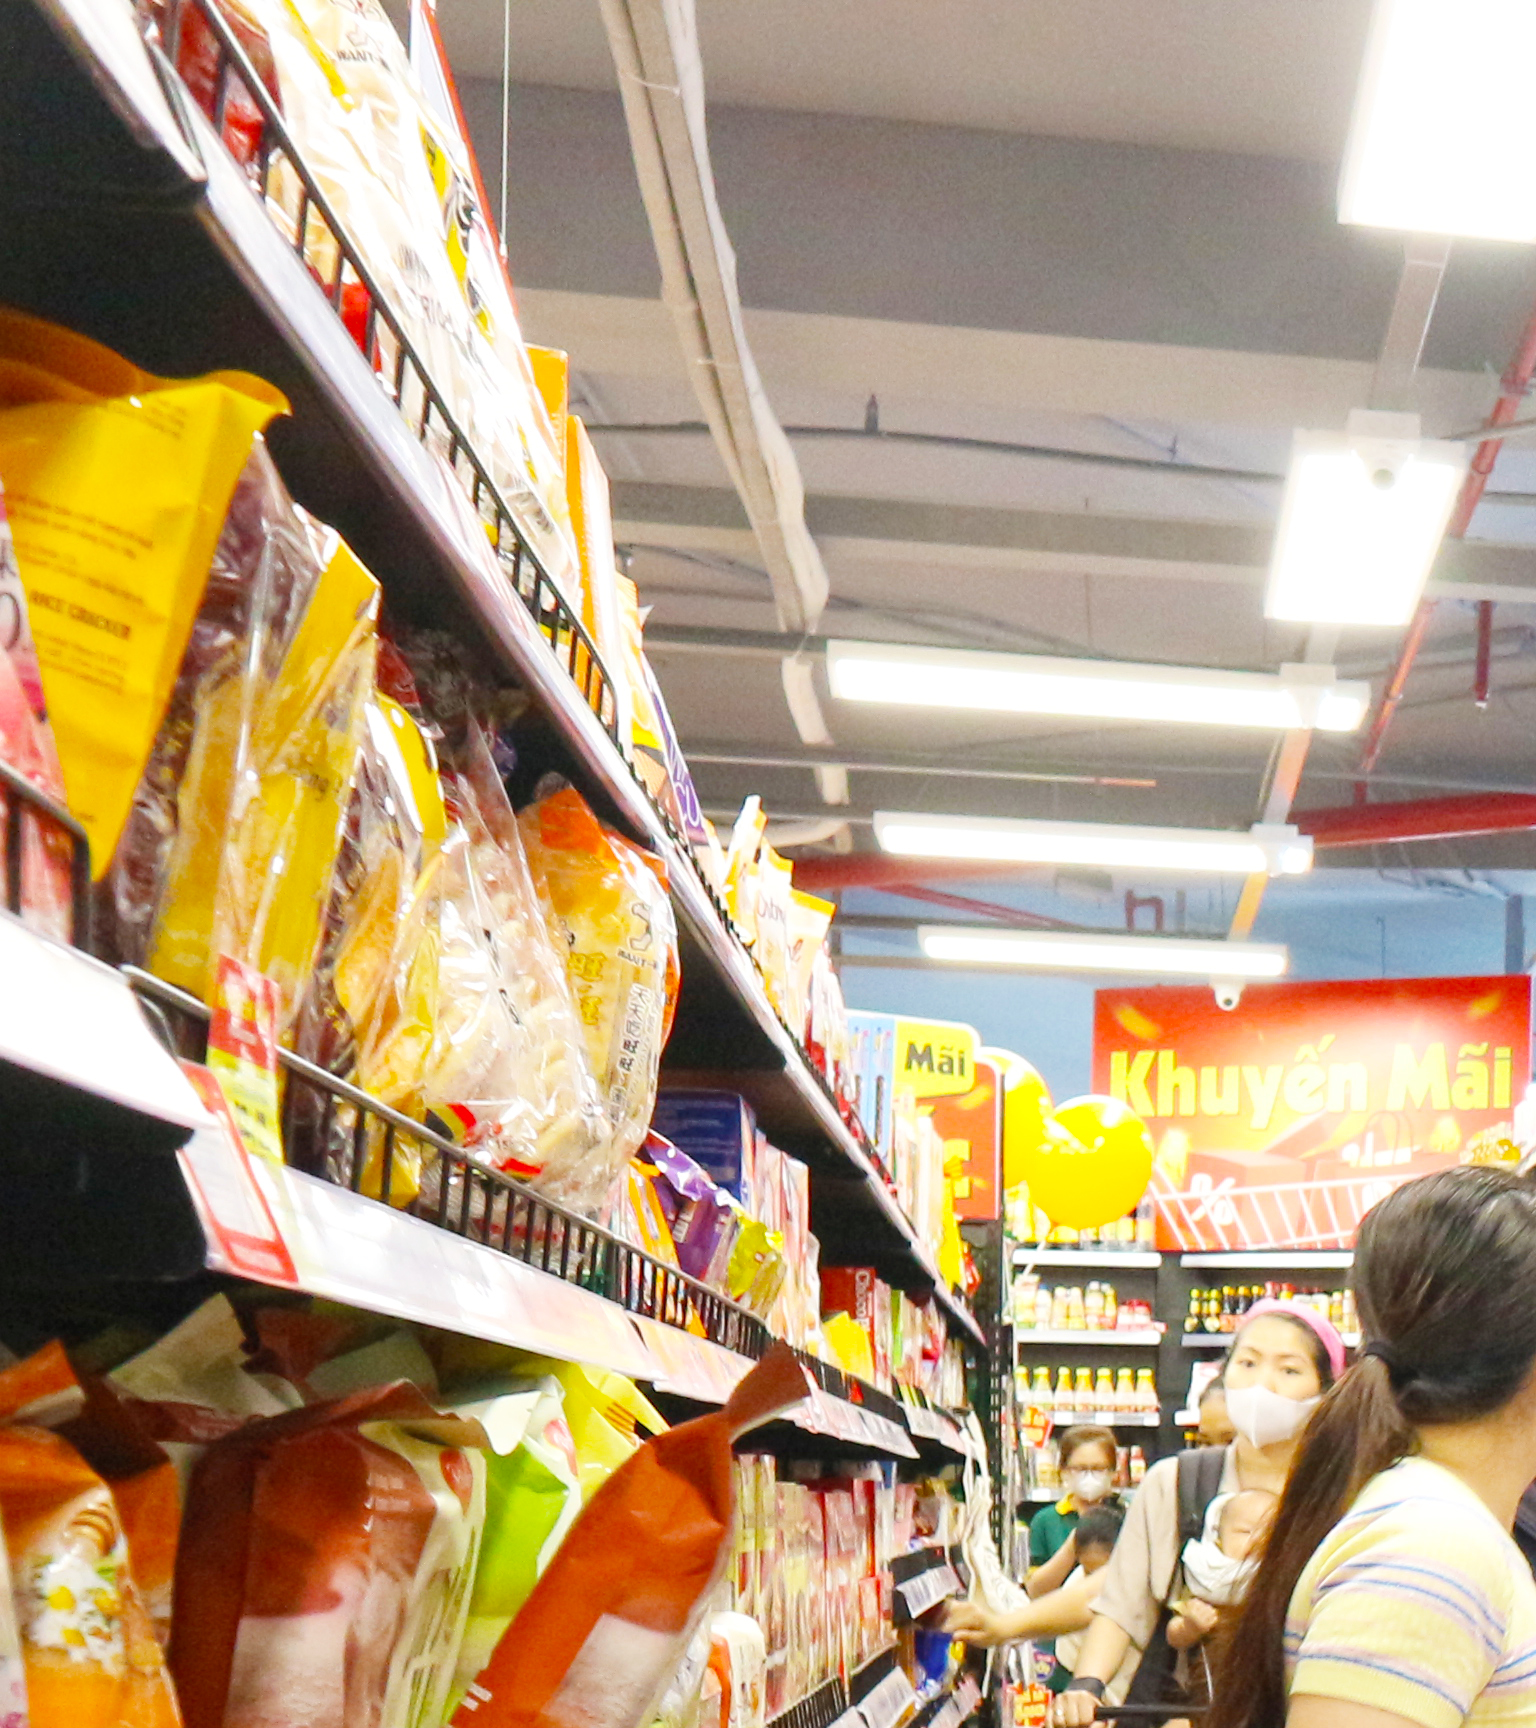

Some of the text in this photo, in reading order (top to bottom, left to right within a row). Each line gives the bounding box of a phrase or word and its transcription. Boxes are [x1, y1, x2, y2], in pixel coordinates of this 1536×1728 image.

[904, 1040, 966, 1078] Mãi
[1110, 1033, 1513, 1128] Khuyến Mãi
